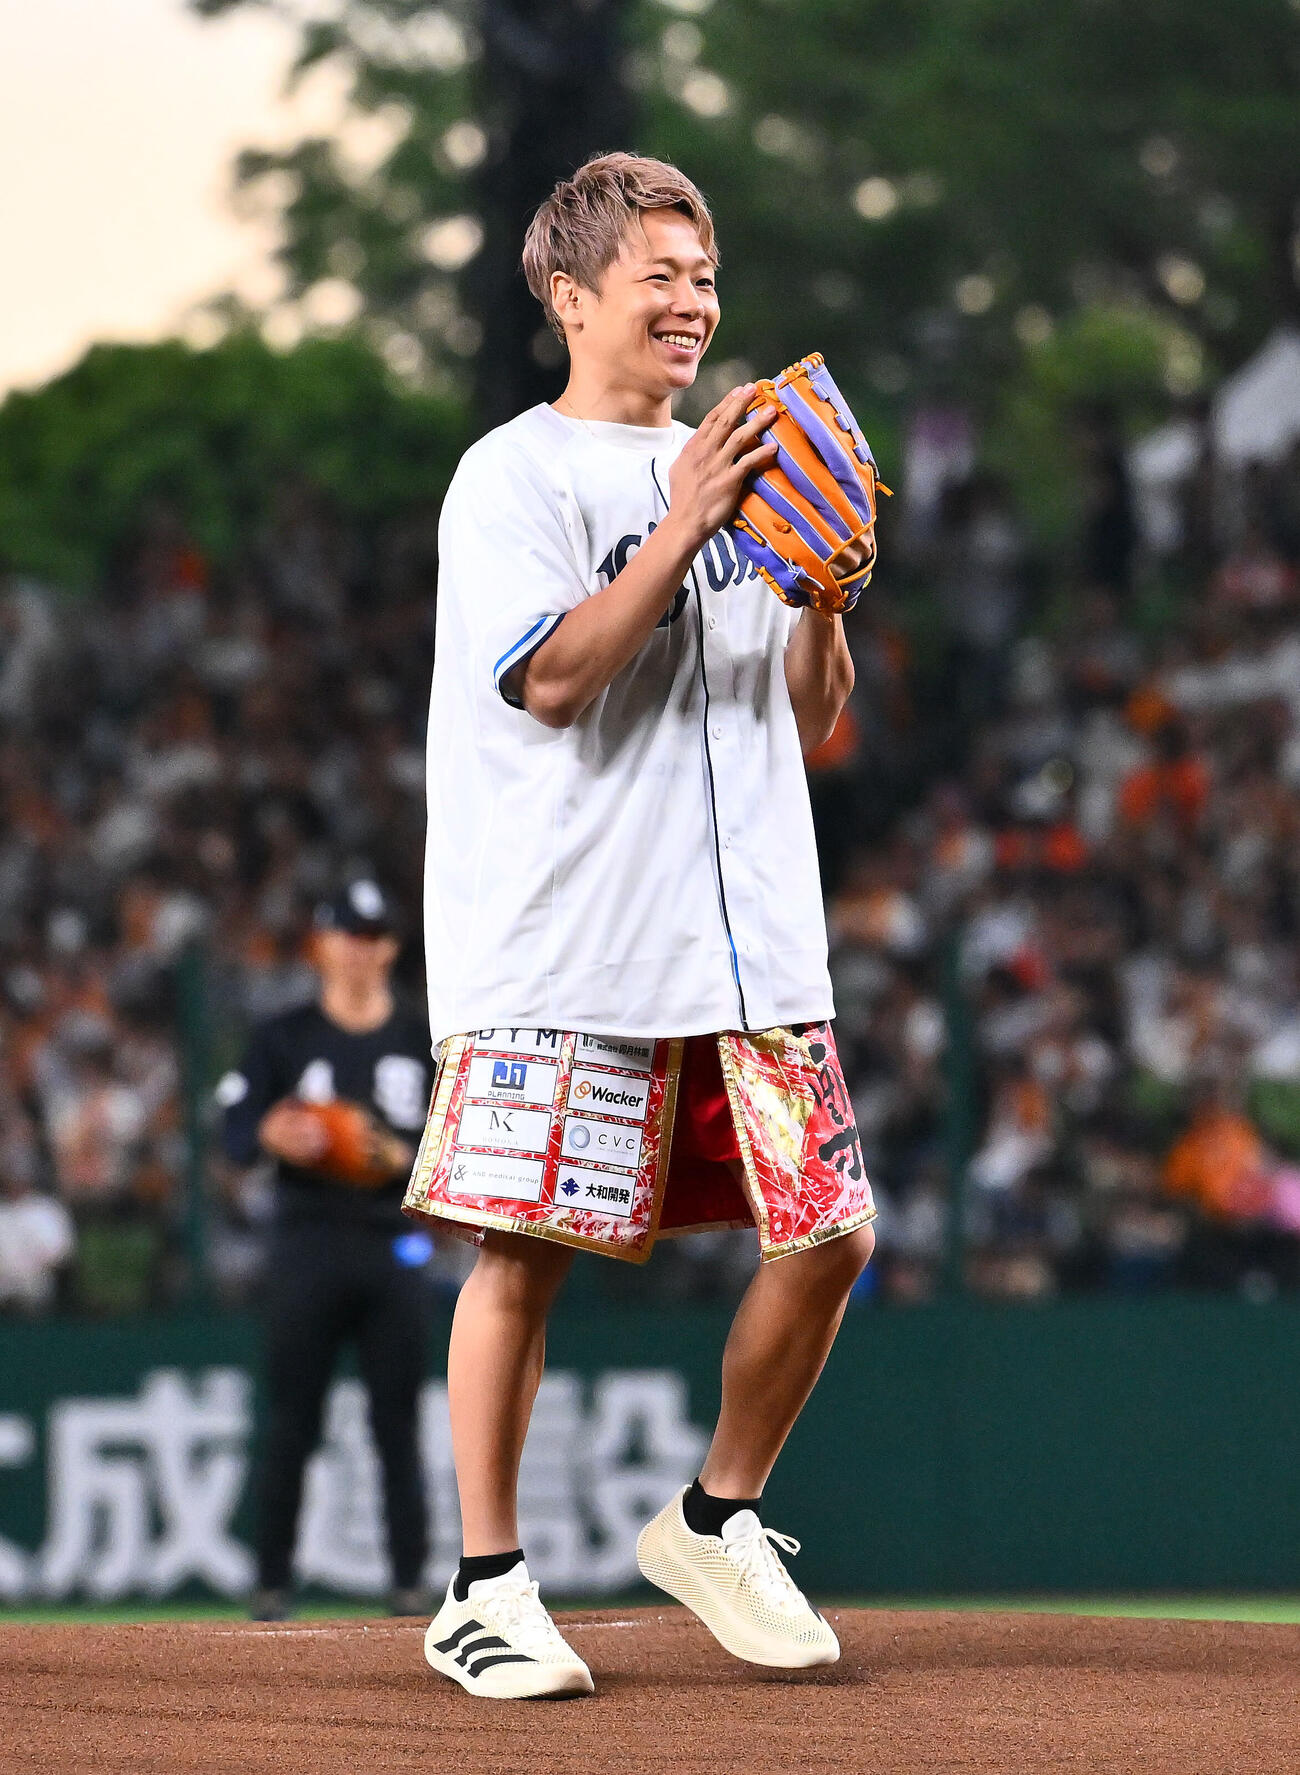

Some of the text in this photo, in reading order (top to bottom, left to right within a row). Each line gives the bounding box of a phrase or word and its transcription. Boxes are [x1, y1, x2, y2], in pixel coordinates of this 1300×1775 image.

[488, 1090, 525, 1101] PLANNING
[592, 1085, 645, 1108] Wacker
[598, 1133, 636, 1150] CVC
[488, 1172, 516, 1182] medical
[518, 1176, 539, 1185] group
[585, 1182, 631, 1205] 大和開発
